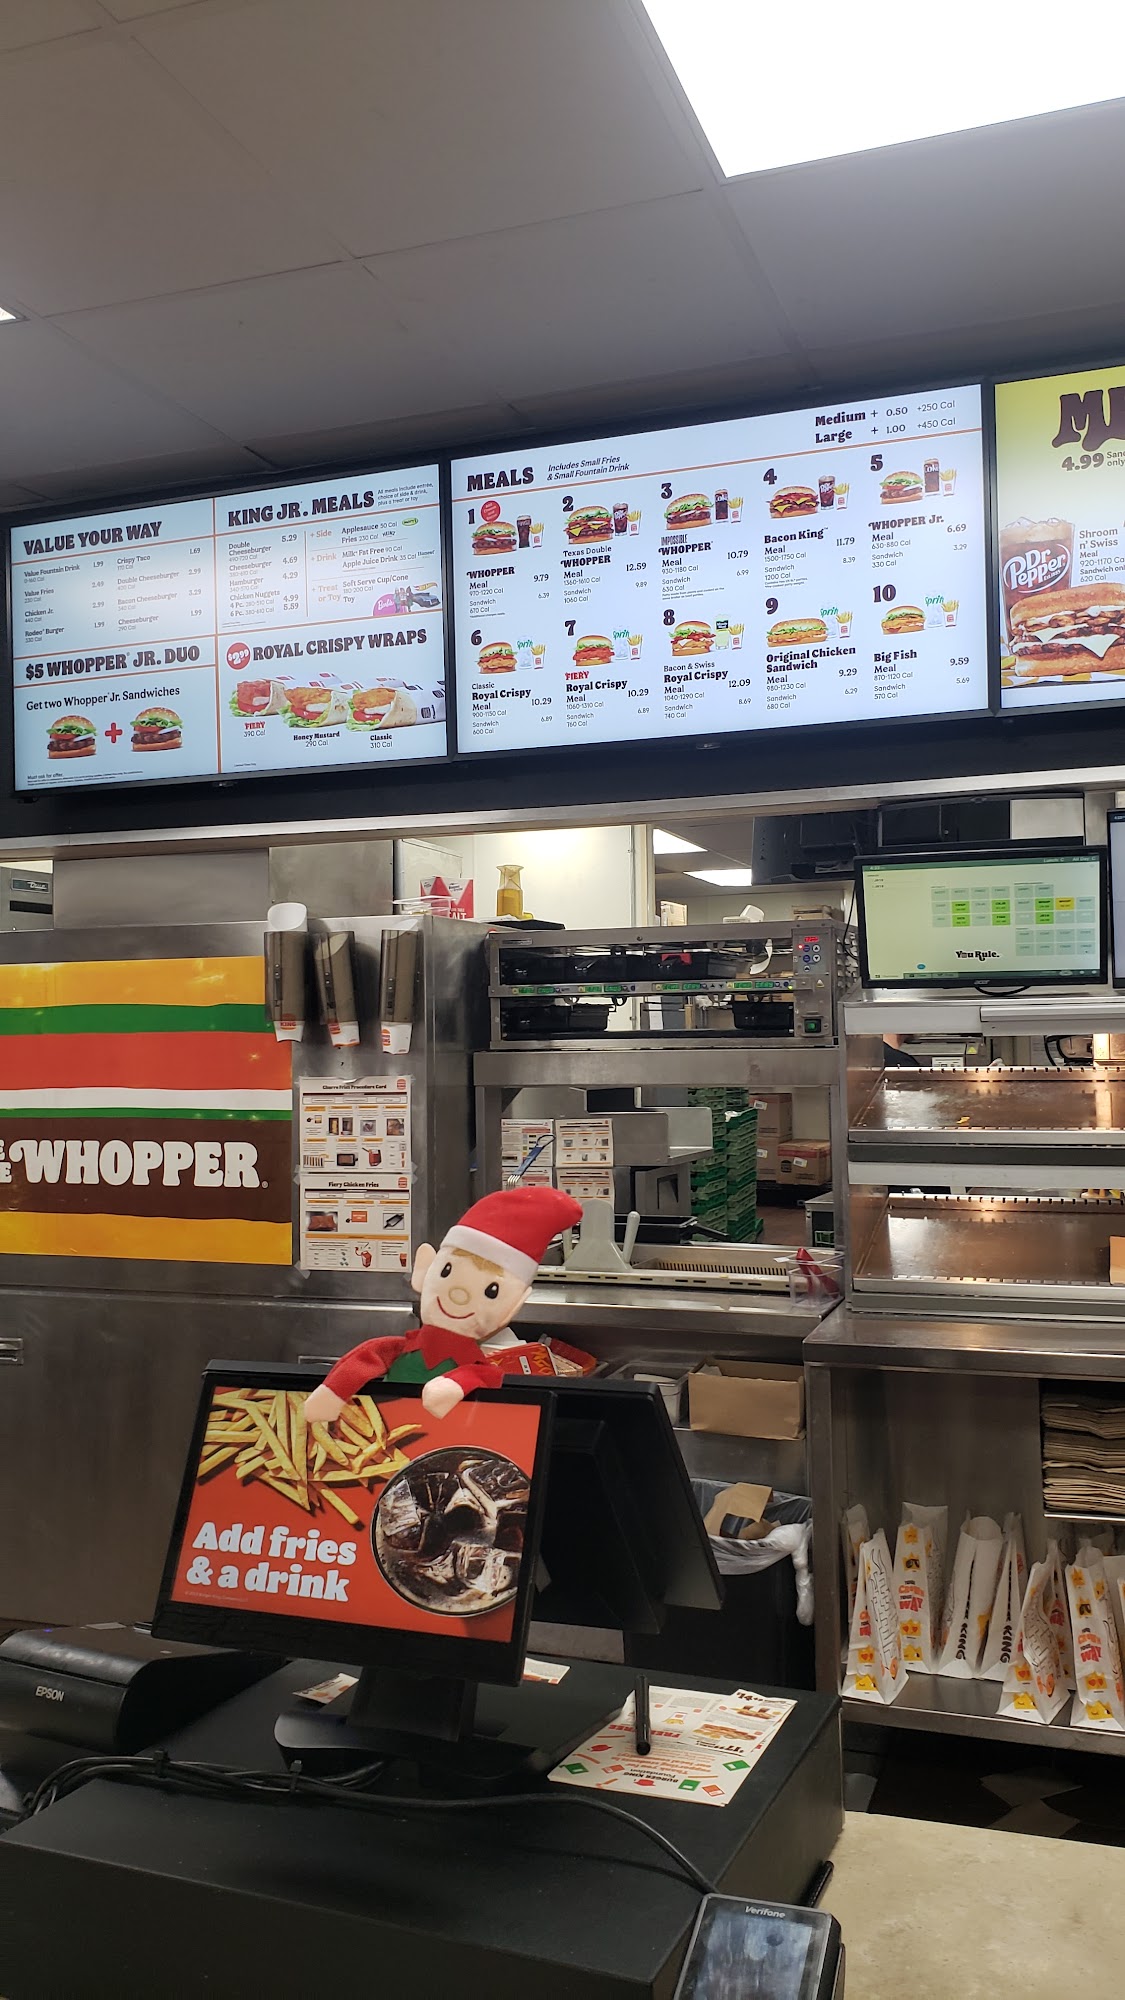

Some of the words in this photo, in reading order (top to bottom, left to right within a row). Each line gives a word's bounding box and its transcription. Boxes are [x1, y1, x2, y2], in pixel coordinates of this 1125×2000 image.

[815, 412, 866, 426] Medium
[886, 407, 908, 416] 0.50
[917, 403, 938, 412] +250
[940, 401, 955, 409] Cal
[815, 430, 852, 443] Large
[886, 425, 906, 434] 1.00
[917, 420, 938, 429] +450
[941, 418, 956, 426] Cal
[548, 461, 580, 472] Includes
[580, 459, 600, 468] Small
[601, 456, 620, 465] Fries
[871, 454, 883, 471] 5
[1062, 453, 1104, 471] 4.99
[554, 471, 574, 481] Small
[575, 467, 608, 478] Fountain
[609, 463, 629, 472] Drink
[763, 468, 777, 485] 4
[467, 467, 534, 492] MEALS
[660, 483, 672, 499] 3
[228, 505, 273, 527] KING
[312, 490, 374, 515] MEALS
[562, 496, 574, 512] 2
[468, 509, 475, 524] 1
[868, 516, 926, 530] WHOPPER
[929, 515, 944, 524] Jr.
[947, 524, 966, 533] 6.69
[1080, 529, 1118, 538] Shroom
[24, 534, 75, 555] VALUE
[78, 528, 123, 547] YOUR
[126, 521, 162, 540] WAY
[282, 534, 297, 542] 5.29
[661, 534, 688, 546] IMPOSSIBLE
[764, 532, 797, 544] Bacon
[836, 537, 855, 547] 11.79
[872, 532, 894, 542] Meal
[1090, 539, 1118, 547] Swiss
[229, 546, 271, 556] Cheeseburger
[586, 546, 611, 554] Double
[658, 542, 712, 556] WHOPPER
[728, 550, 748, 559] 10.79
[765, 545, 785, 555] Meal
[117, 556, 135, 565] Crispy
[283, 556, 298, 564] 4.69
[317, 553, 336, 561] Drink
[561, 555, 611, 568] WHOPPER
[662, 558, 682, 567] Meal
[1025, 549, 1051, 570] Dr
[230, 561, 272, 571] Cheeseburger
[626, 562, 646, 572] 12.59
[1003, 554, 1065, 590] Pepper
[283, 572, 298, 580] 4.29
[467, 567, 515, 579] WHOPPER
[534, 574, 549, 582] 9.79
[564, 570, 583, 579] Meal
[230, 577, 263, 586] Hamburger
[470, 581, 488, 589] Meal
[284, 594, 298, 602] 4.99
[873, 584, 896, 603] 10
[766, 598, 779, 614] 9
[118, 615, 159, 626] Cheeseburger
[663, 609, 675, 626] 8
[565, 620, 576, 636] 7
[471, 630, 482, 645] 6
[253, 644, 304, 661] ROYAL
[306, 635, 365, 654] CRISPY
[368, 629, 427, 648] WRAPS
[766, 651, 810, 664] Original
[812, 646, 856, 658] Chicken
[874, 652, 892, 663] Big
[894, 649, 917, 660] Fish
[26, 664, 44, 680] $5
[133, 651, 161, 667] JR.
[165, 646, 200, 664] DUO
[664, 664, 685, 672] Bacon
[694, 661, 715, 669] Swiss
[766, 660, 817, 673] Sandwich
[950, 657, 969, 666] 9.59
[839, 668, 857, 678] 9.29
[874, 664, 896, 673] Meal
[565, 671, 589, 680] FIERY
[664, 672, 692, 684] Royal
[694, 670, 728, 681] Crispy
[767, 675, 788, 684] Meal
[472, 682, 494, 690] Classic
[566, 682, 593, 693] Royal
[595, 680, 627, 691] Crispy
[664, 685, 684, 694] Meal
[729, 679, 750, 688] 12.09
[26, 701, 43, 711] Get
[44, 699, 62, 710] two
[110, 693, 120, 702] Jr.
[123, 687, 180, 700] Sandwiches
[472, 691, 498, 702] Royal
[500, 689, 531, 700] Crispy
[566, 694, 586, 703] Meal
[628, 689, 649, 697] 10.29
[472, 702, 491, 711] Meal
[532, 698, 552, 706] 10.29
[245, 721, 266, 729] FIERY
[293, 734, 313, 742] Honey
[314, 731, 340, 739] Mustard
[975, 951, 1000, 961] Rule.
[192, 1522, 265, 1555] Add
[268, 1526, 357, 1566] fries
[186, 1556, 213, 1586] &
[217, 1565, 239, 1588] a
[244, 1562, 350, 1602] drink
[956, 1623, 968, 1660] KING
[1000, 1625, 1012, 1663] KING
[35, 1686, 65, 1702] EPSON
[646, 1774, 678, 1783] BURGER
[745, 1906, 786, 1918] Verifone
